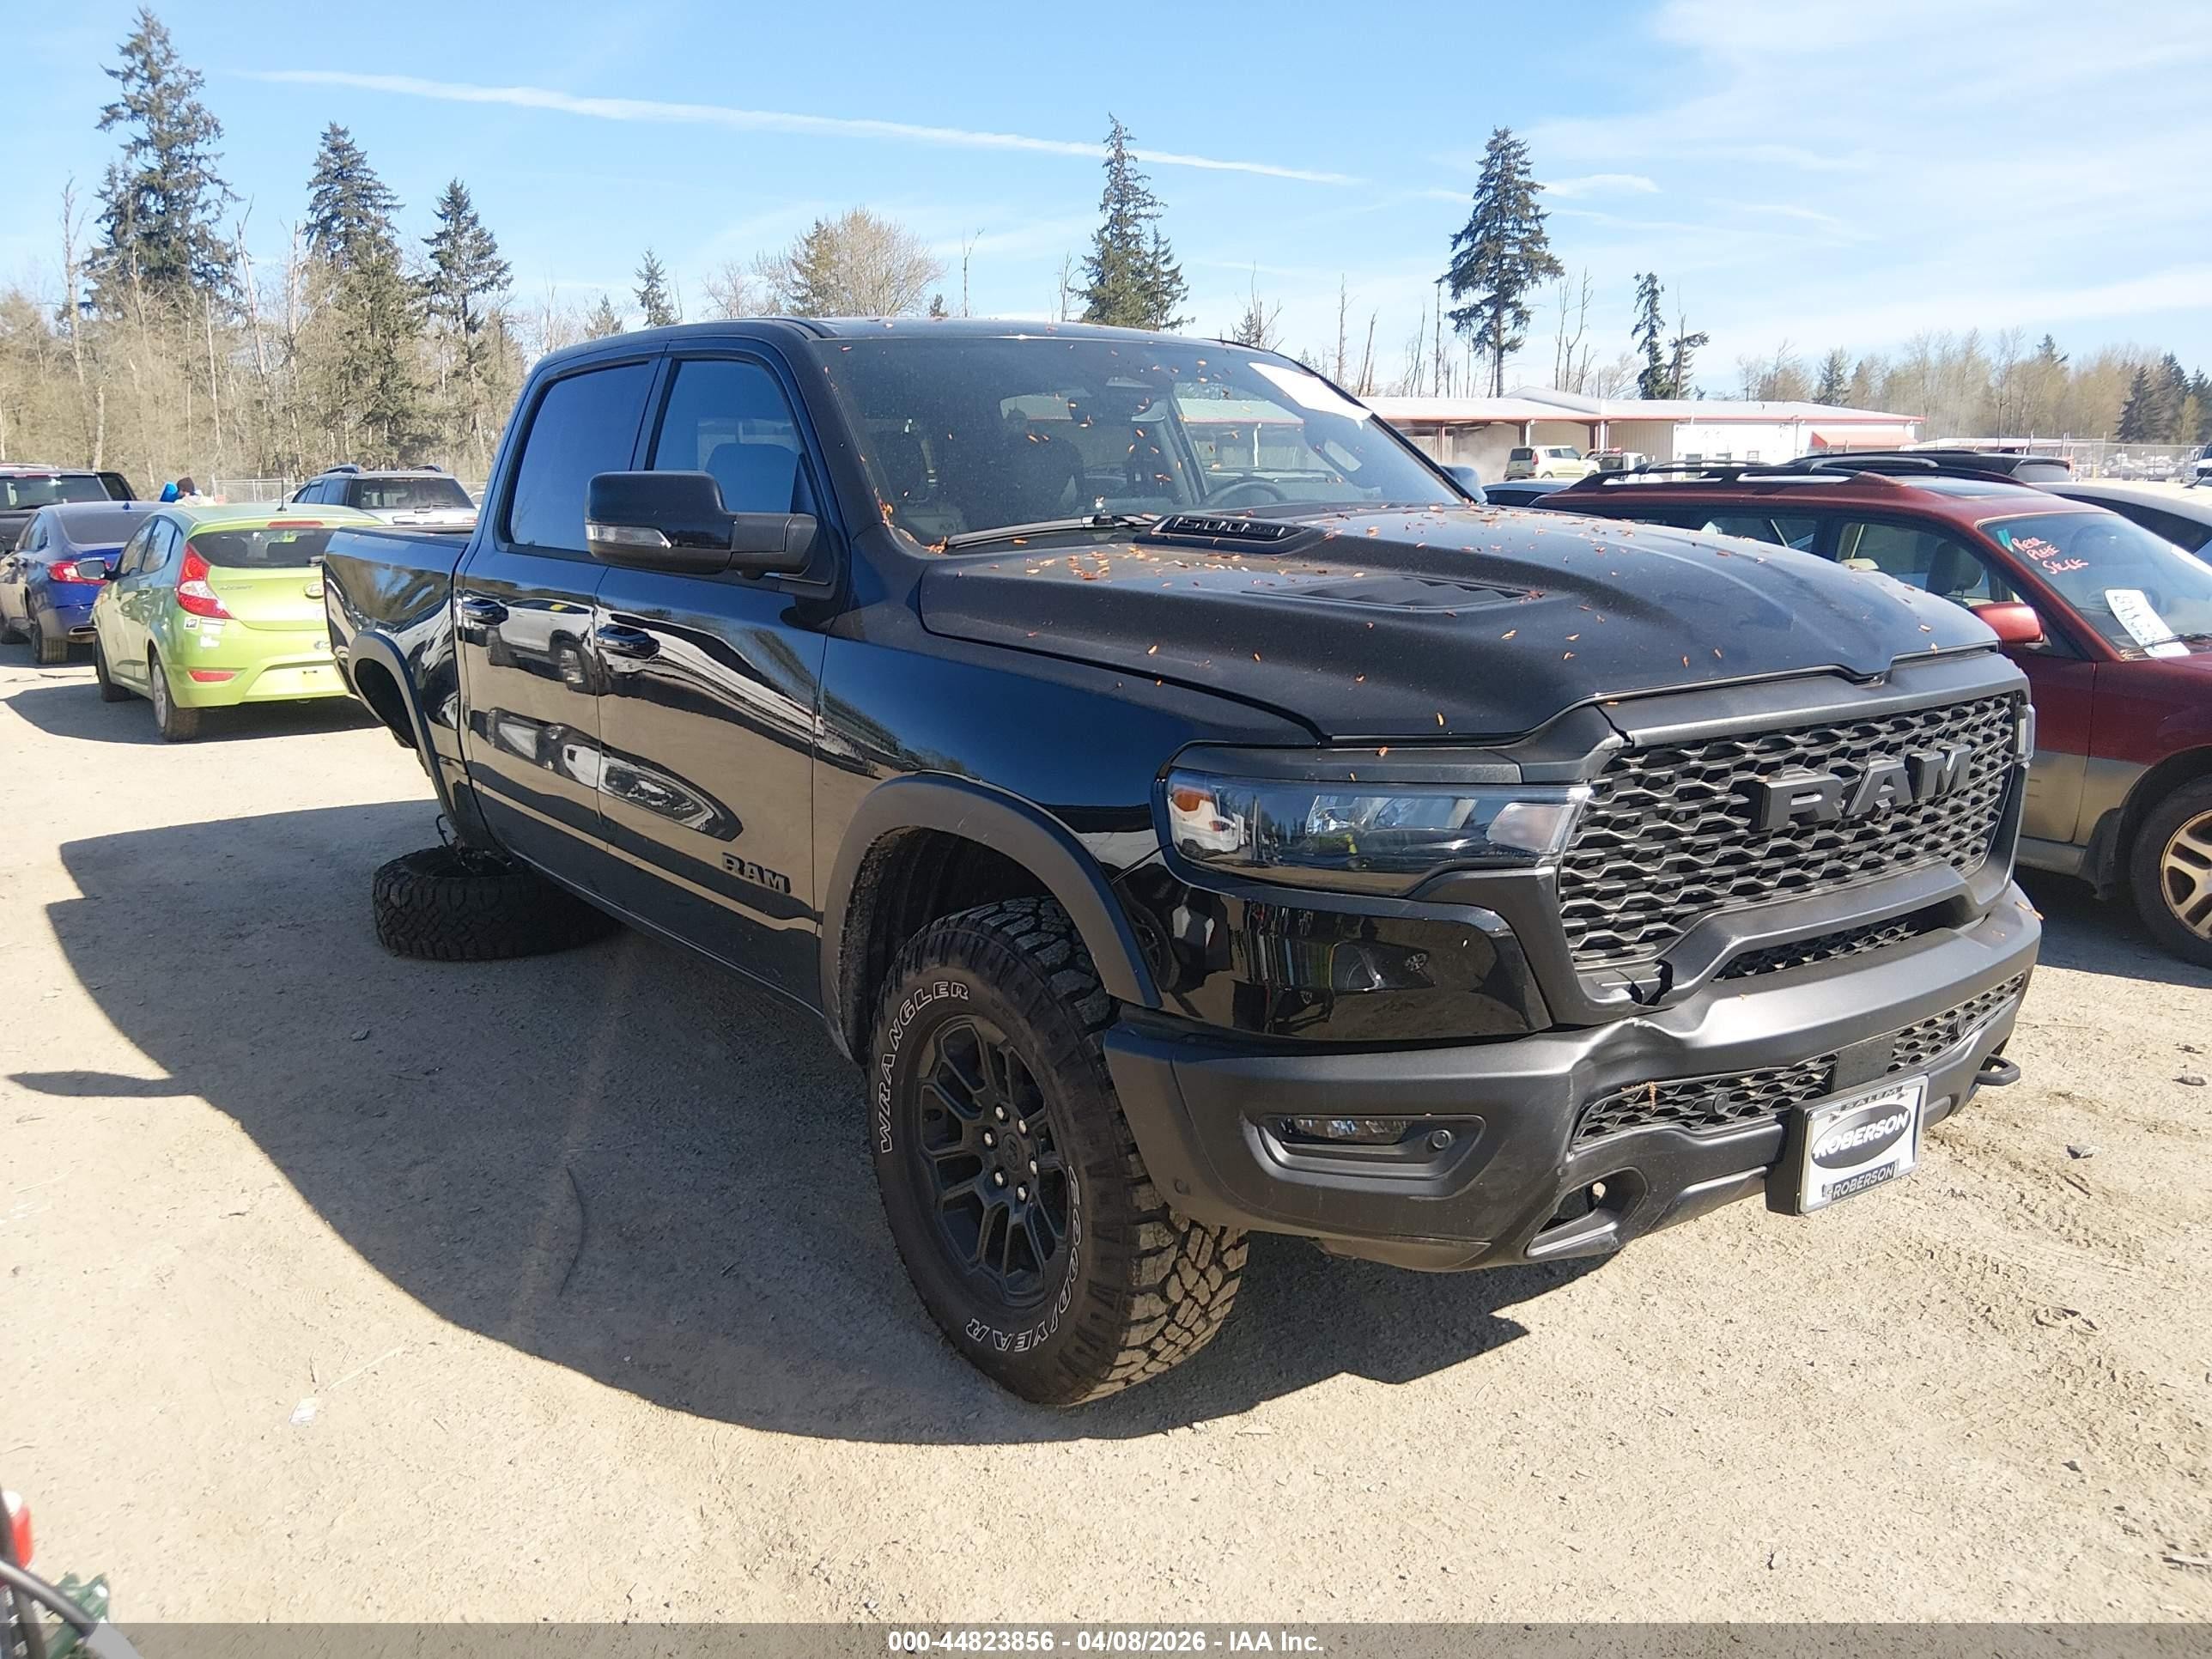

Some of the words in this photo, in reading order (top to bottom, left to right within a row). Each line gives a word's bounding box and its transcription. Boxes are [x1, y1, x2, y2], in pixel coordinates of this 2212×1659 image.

[1174, 516, 1250, 533] 1500
[1762, 744, 1972, 830] RAM
[722, 852, 791, 893] RAM
[878, 981, 969, 1154] WRANGLER
[1840, 1085, 1904, 1111] SALEM
[1811, 1109, 1911, 1159] ROBERSON
[1832, 1164, 1894, 1199] ROBERSON
[965, 1164, 1082, 1352] GOODYEAR
